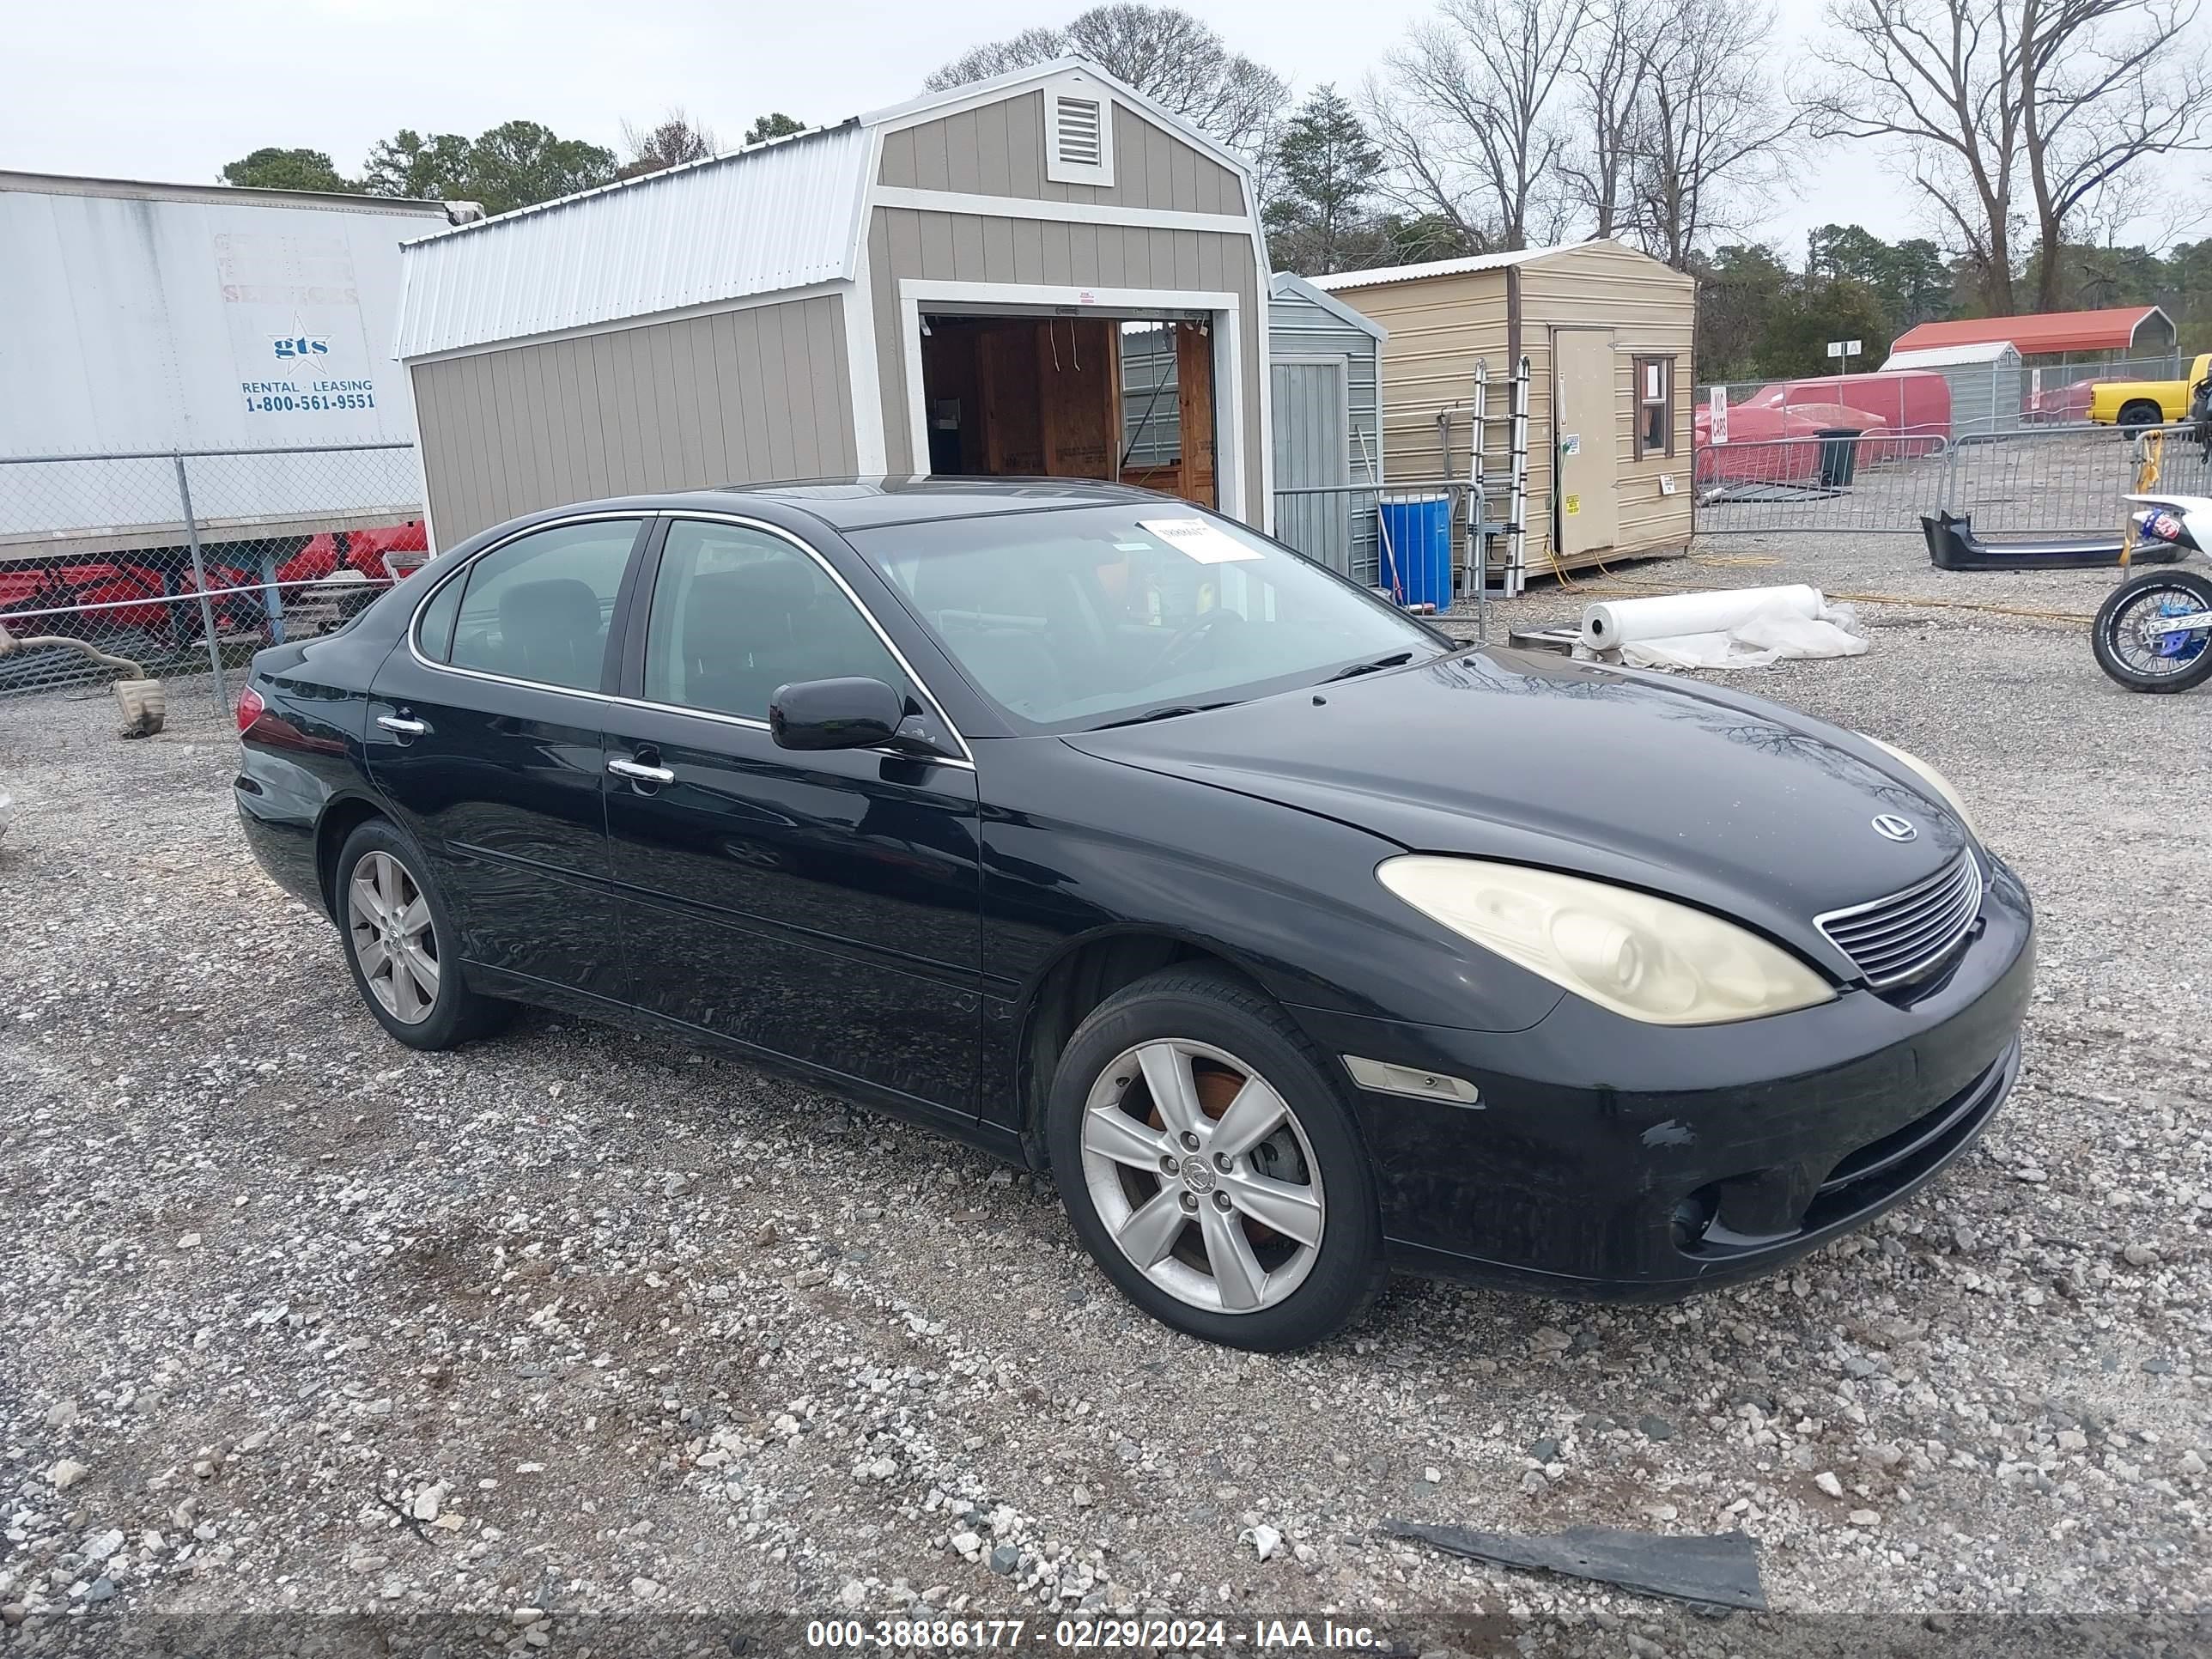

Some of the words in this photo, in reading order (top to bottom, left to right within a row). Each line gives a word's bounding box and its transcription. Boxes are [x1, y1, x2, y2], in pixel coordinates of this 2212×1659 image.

[274, 337, 328, 360] gts
[241, 382, 300, 393] RENTAL
[313, 380, 373, 392] LEASING
[246, 393, 375, 412] 1-800-561-9551
[1712, 417, 1726, 437] CARS
